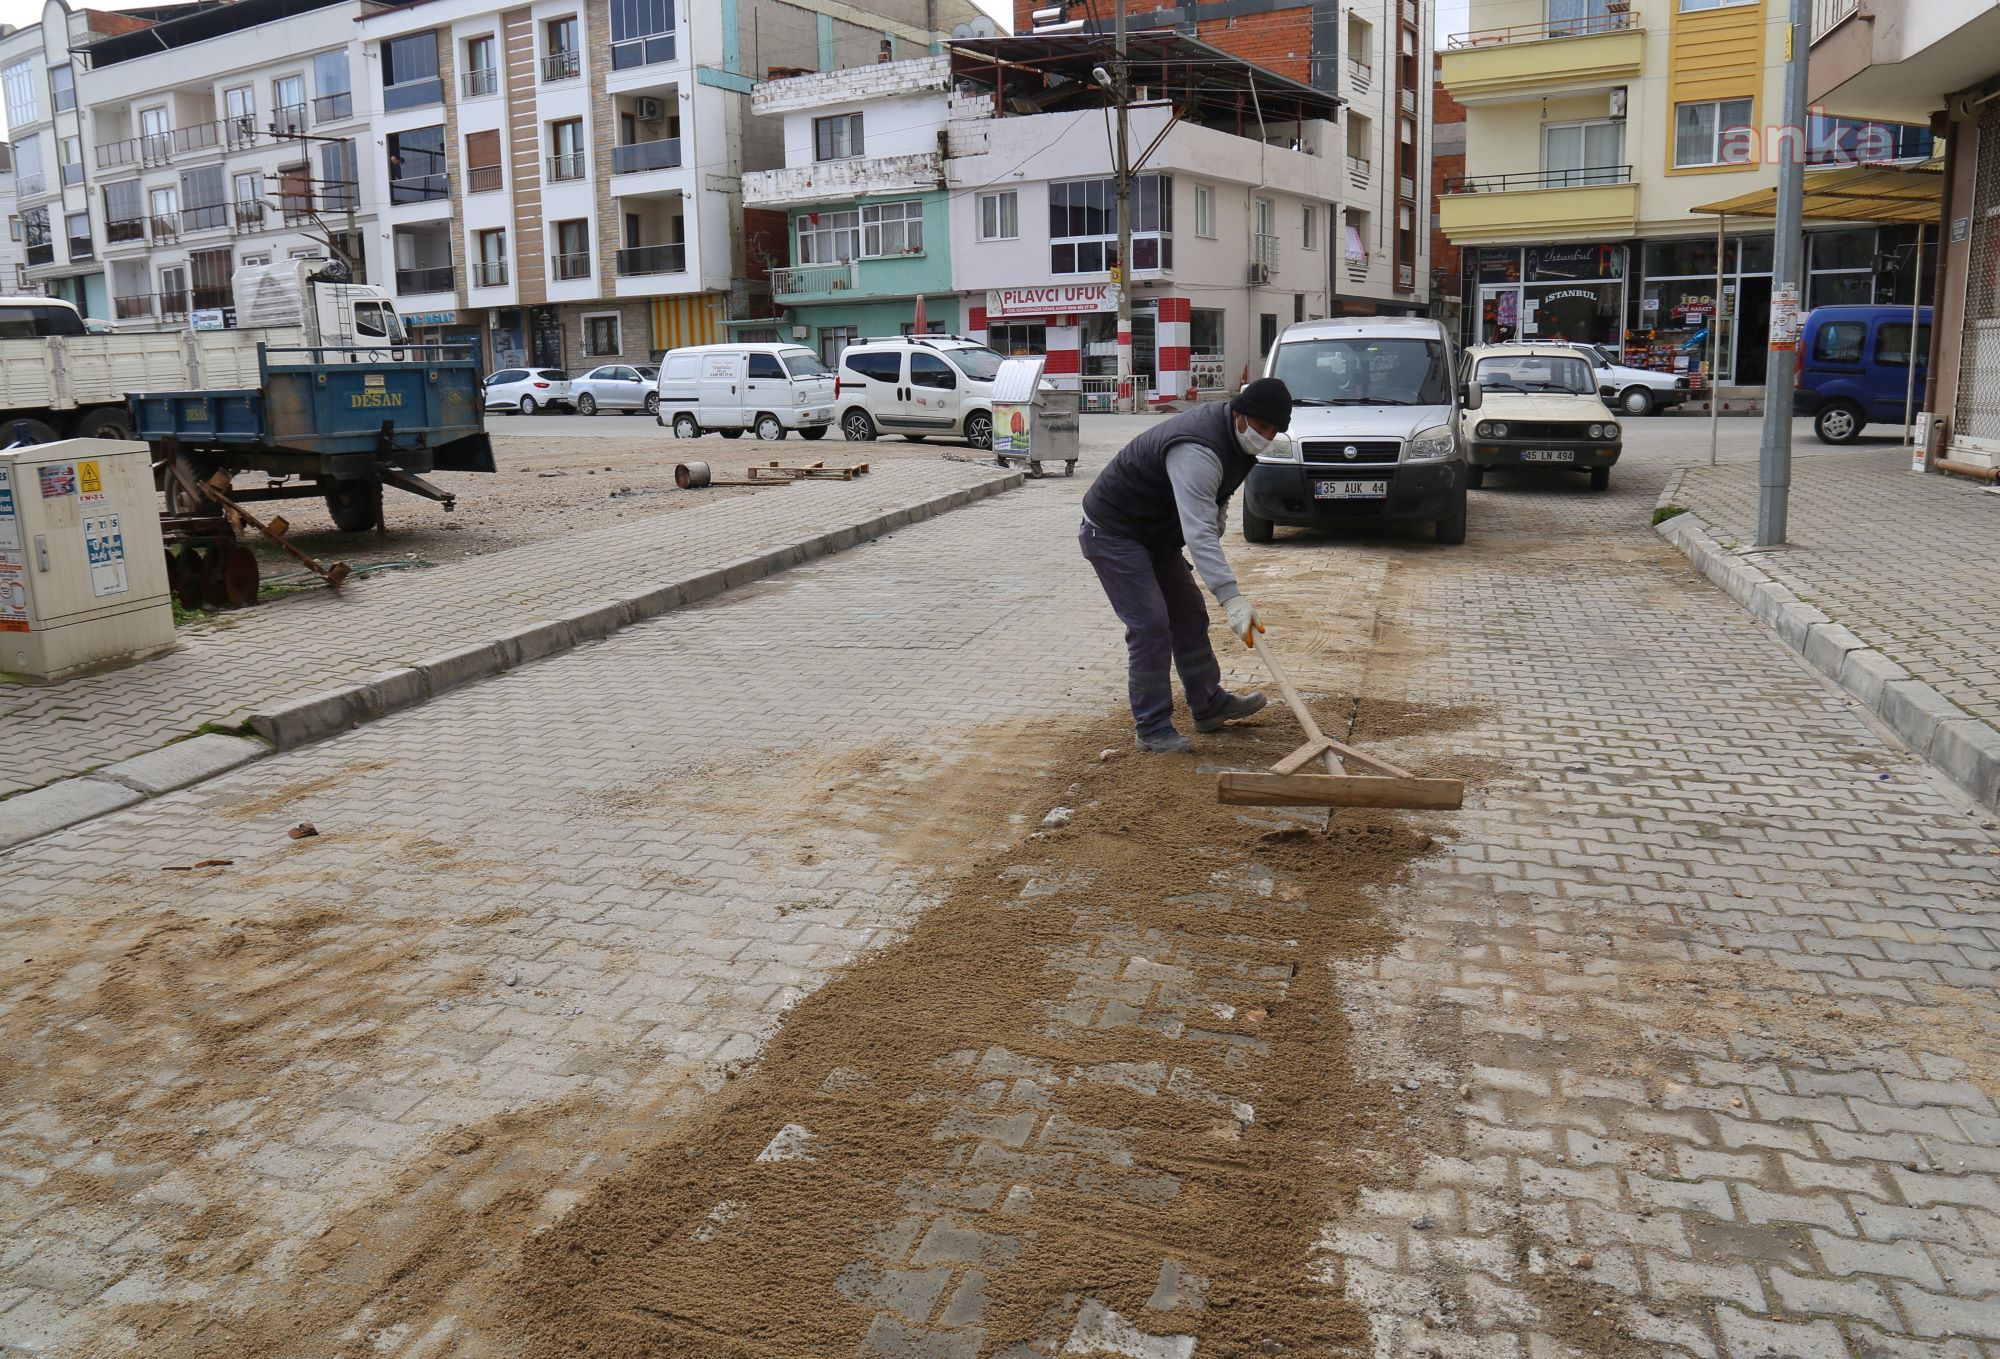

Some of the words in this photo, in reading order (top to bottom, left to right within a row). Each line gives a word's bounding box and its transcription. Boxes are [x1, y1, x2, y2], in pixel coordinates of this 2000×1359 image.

[1065, 285, 1107, 301] UFUK
[351, 393, 402, 408] DESAN
[1526, 451, 1537, 460] 45
[1541, 451, 1553, 460] LN
[1557, 451, 1573, 461] 494
[1323, 483, 1336, 494] 35
[1344, 482, 1363, 494] AUK
[1372, 482, 1385, 494] 44
